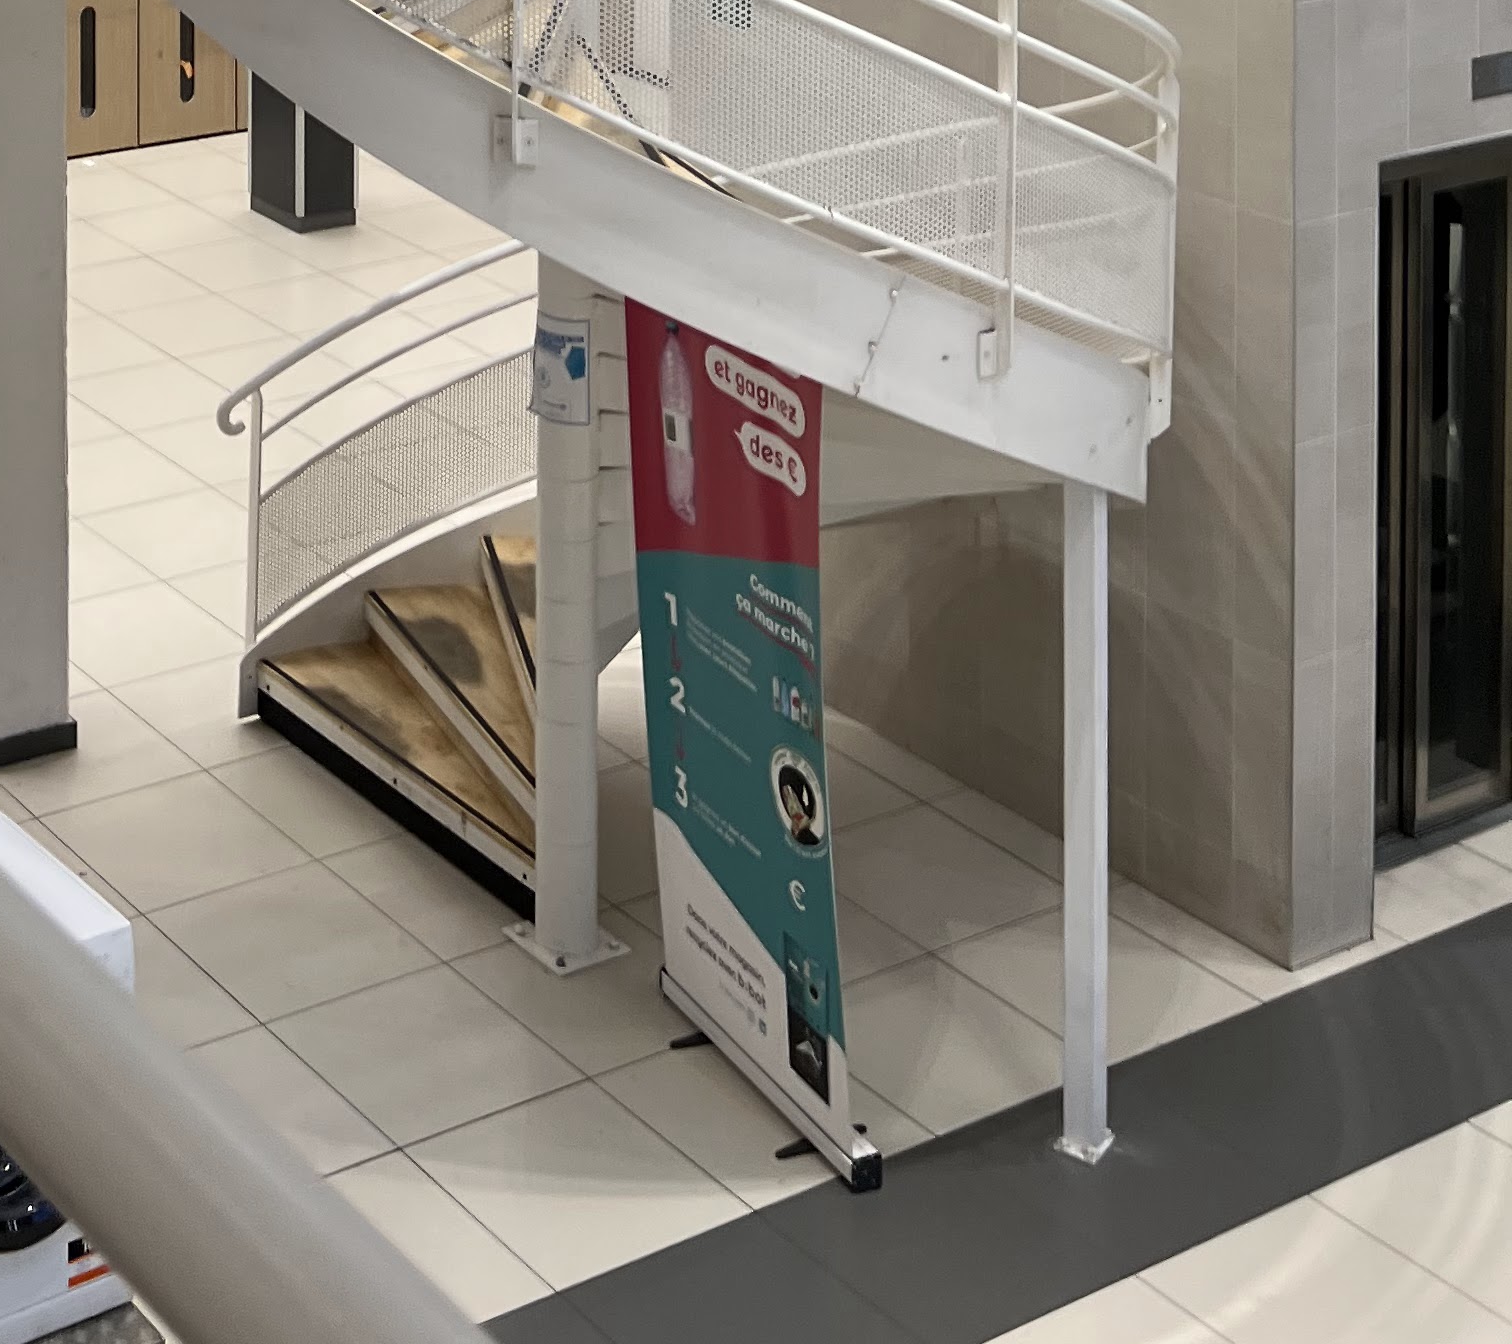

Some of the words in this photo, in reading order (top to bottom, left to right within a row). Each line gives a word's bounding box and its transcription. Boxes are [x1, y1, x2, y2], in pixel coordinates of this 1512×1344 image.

[714, 359, 731, 383] et
[735, 371, 797, 426] gagnez
[750, 434, 784, 470] des
[664, 591, 678, 627] 1
[754, 606, 808, 653] marche
[669, 676, 687, 714] 2
[674, 764, 688, 809] 3
